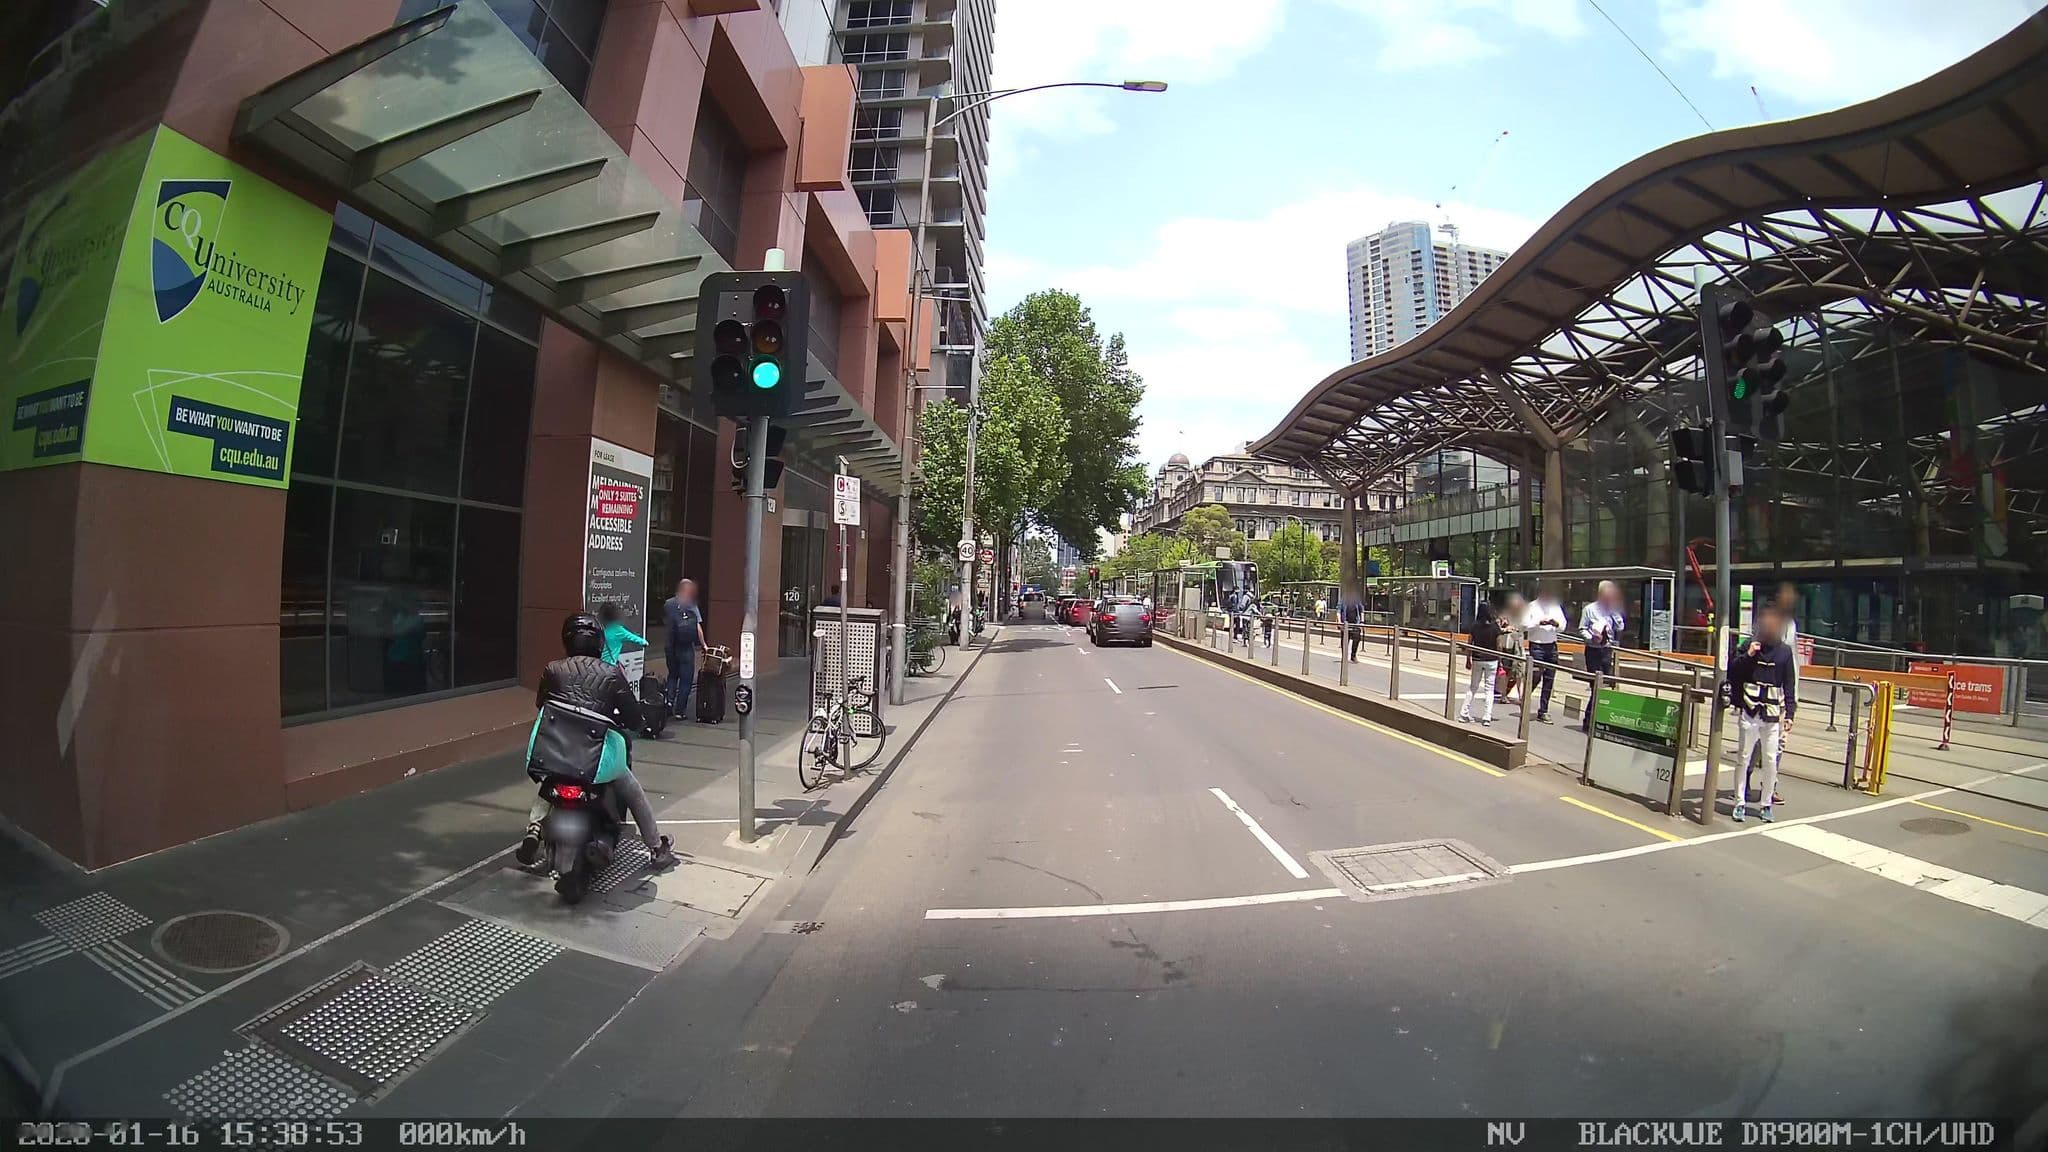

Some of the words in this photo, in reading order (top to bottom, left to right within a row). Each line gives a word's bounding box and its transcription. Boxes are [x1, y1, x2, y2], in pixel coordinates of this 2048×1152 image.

[207, 279, 271, 313] AUSTRALIA
[175, 407, 188, 423] BE
[188, 410, 216, 428] WHAT
[216, 416, 234, 431] YOU
[234, 420, 260, 437] WANT
[260, 425, 271, 440] TO
[271, 428, 283, 442] BE
[220, 447, 279, 470] cqu.edu.au
[594, 449, 603, 459] FOR
[599, 489, 614, 501] ONLY
[615, 490, 620, 501] 2
[620, 491, 637, 502] SUITES
[602, 503, 633, 514] REMAINING
[589, 513, 633, 534] ACCESSIBLE
[588, 533, 624, 551] ADDRESS
[962, 547, 973, 555] 40
[784, 591, 800, 602] 120
[1967, 681, 1992, 693] trams
[1656, 768, 1671, 782] 122
